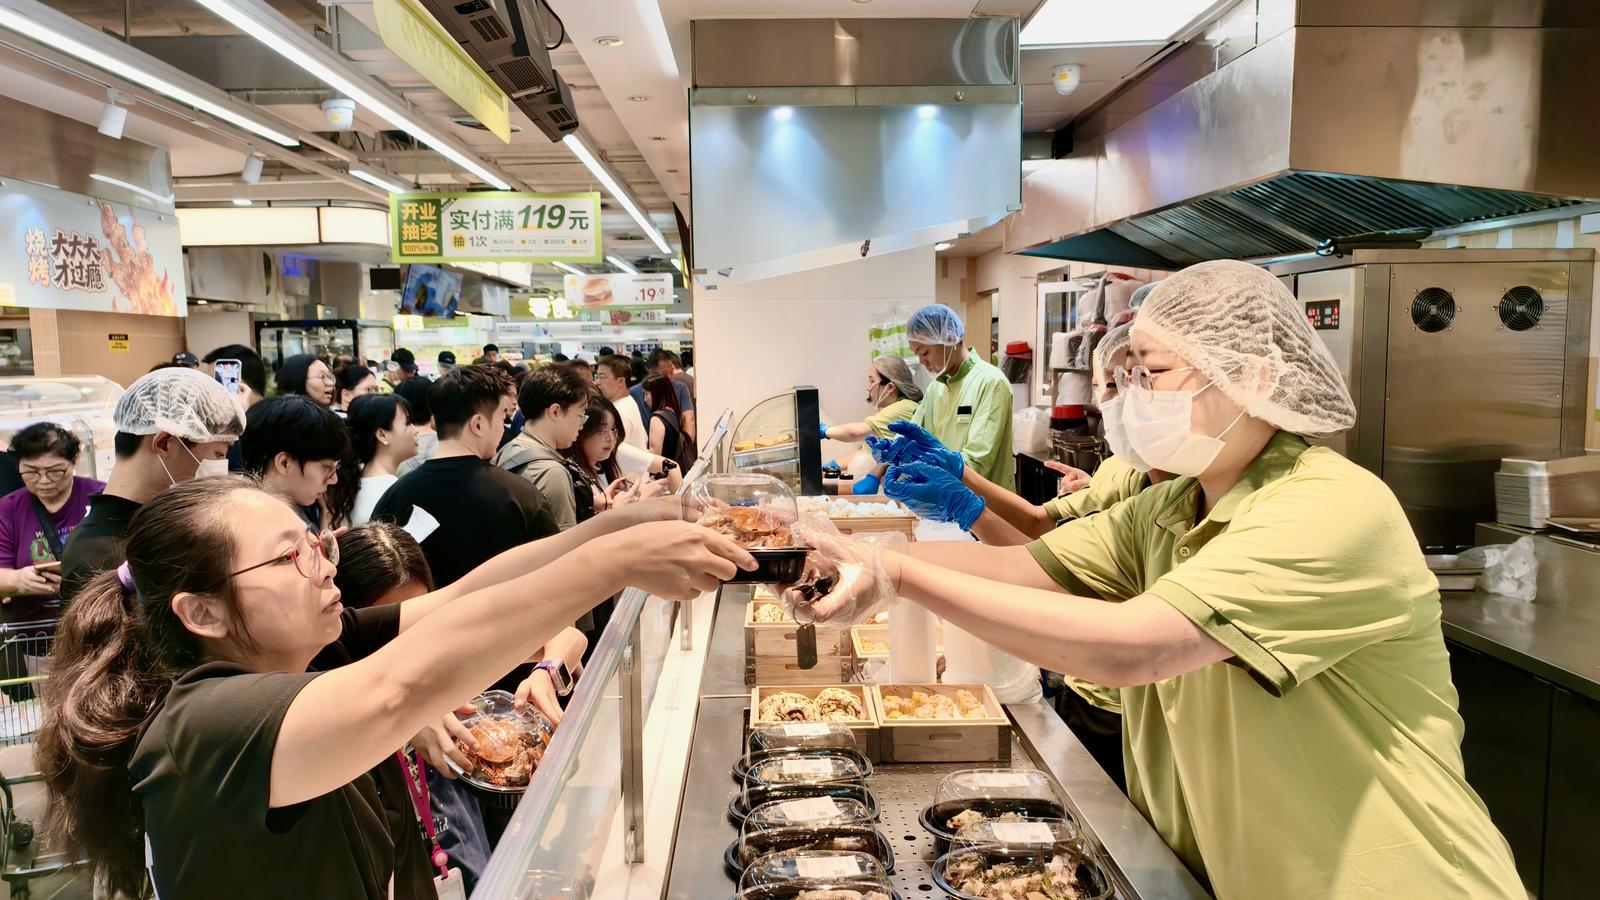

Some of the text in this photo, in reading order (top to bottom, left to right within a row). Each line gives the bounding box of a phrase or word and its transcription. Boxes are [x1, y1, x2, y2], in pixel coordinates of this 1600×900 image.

[401, 203, 437, 221] 开业
[402, 222, 438, 241] 抽奖
[26, 228, 49, 288] 烧烤
[52, 232, 101, 260] 大大大
[54, 259, 105, 290] 才过瘾
